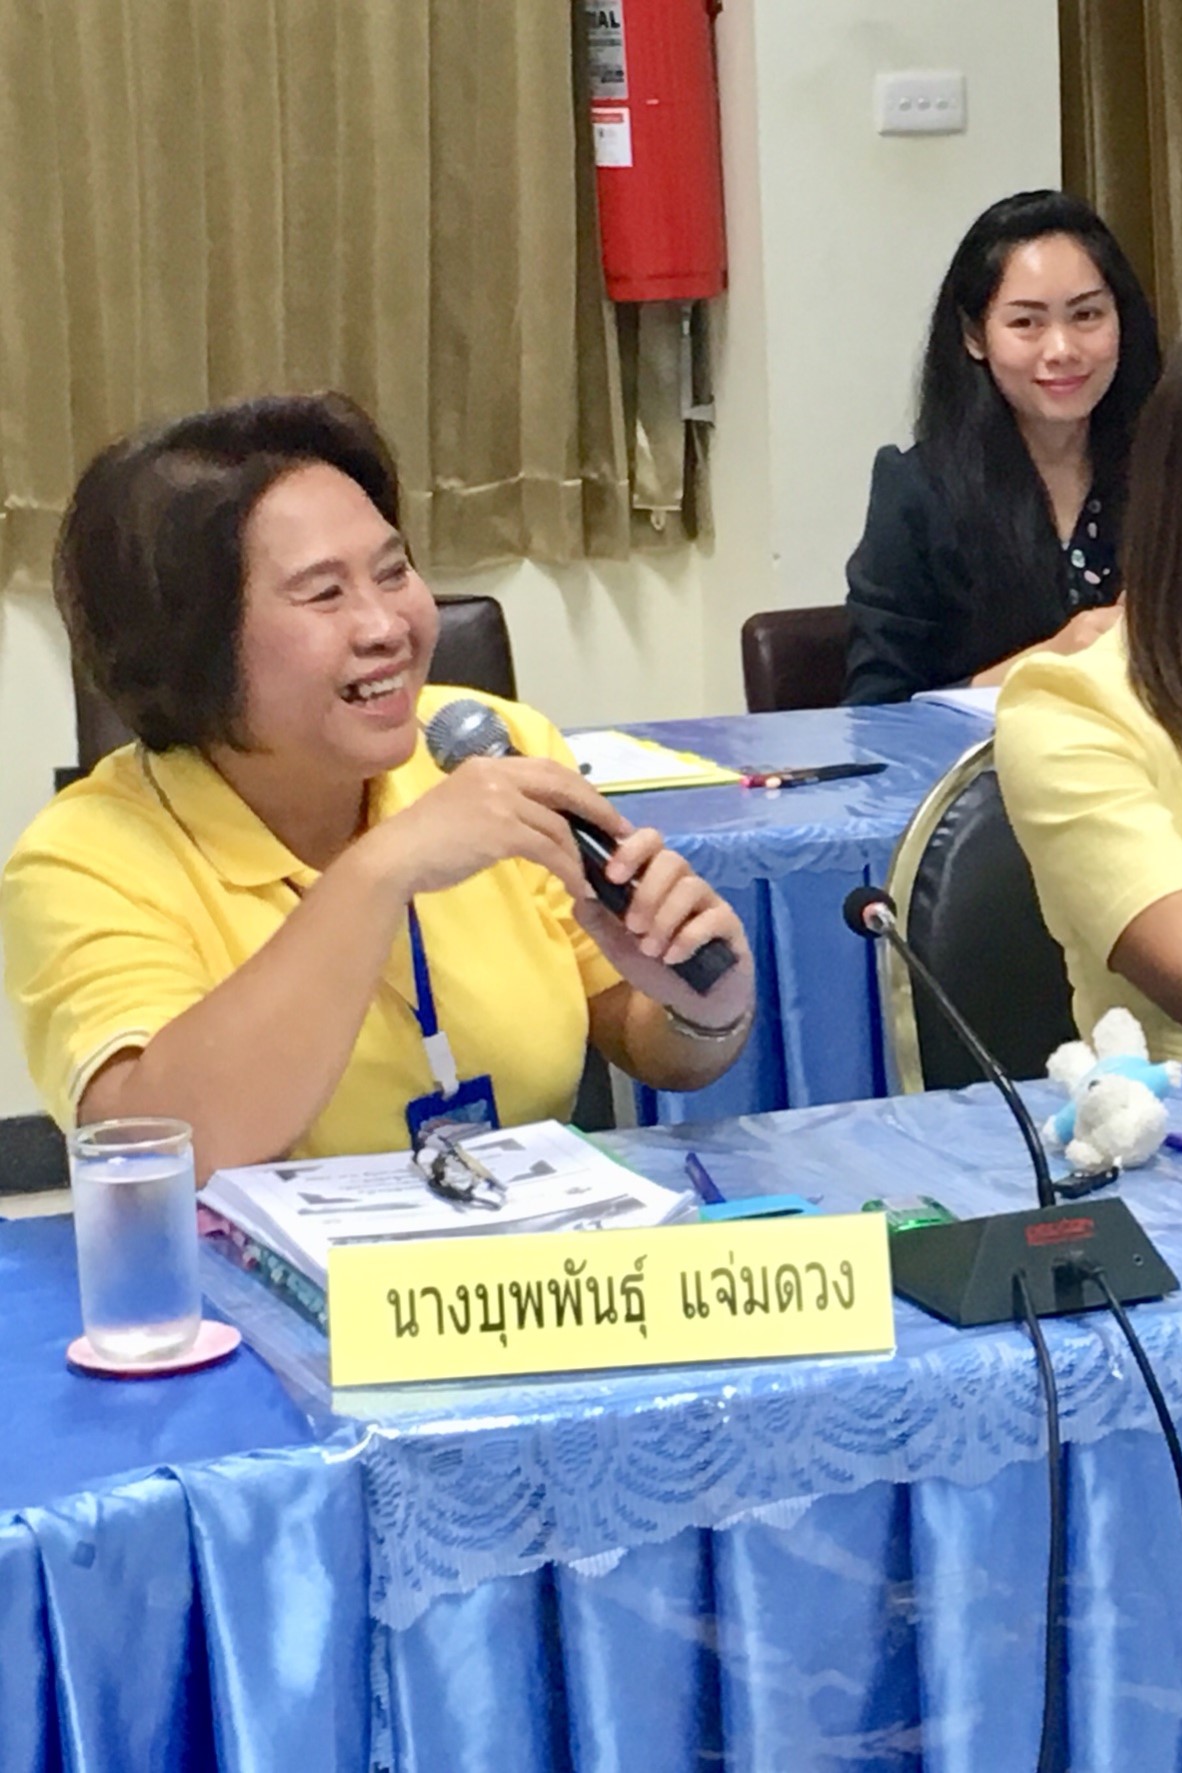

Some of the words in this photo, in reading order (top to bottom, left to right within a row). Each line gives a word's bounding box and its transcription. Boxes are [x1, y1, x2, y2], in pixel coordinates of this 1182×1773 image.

[387, 1254, 648, 1348] นางบุพพันธุ์
[679, 1250, 855, 1320] แจ่มดวง
